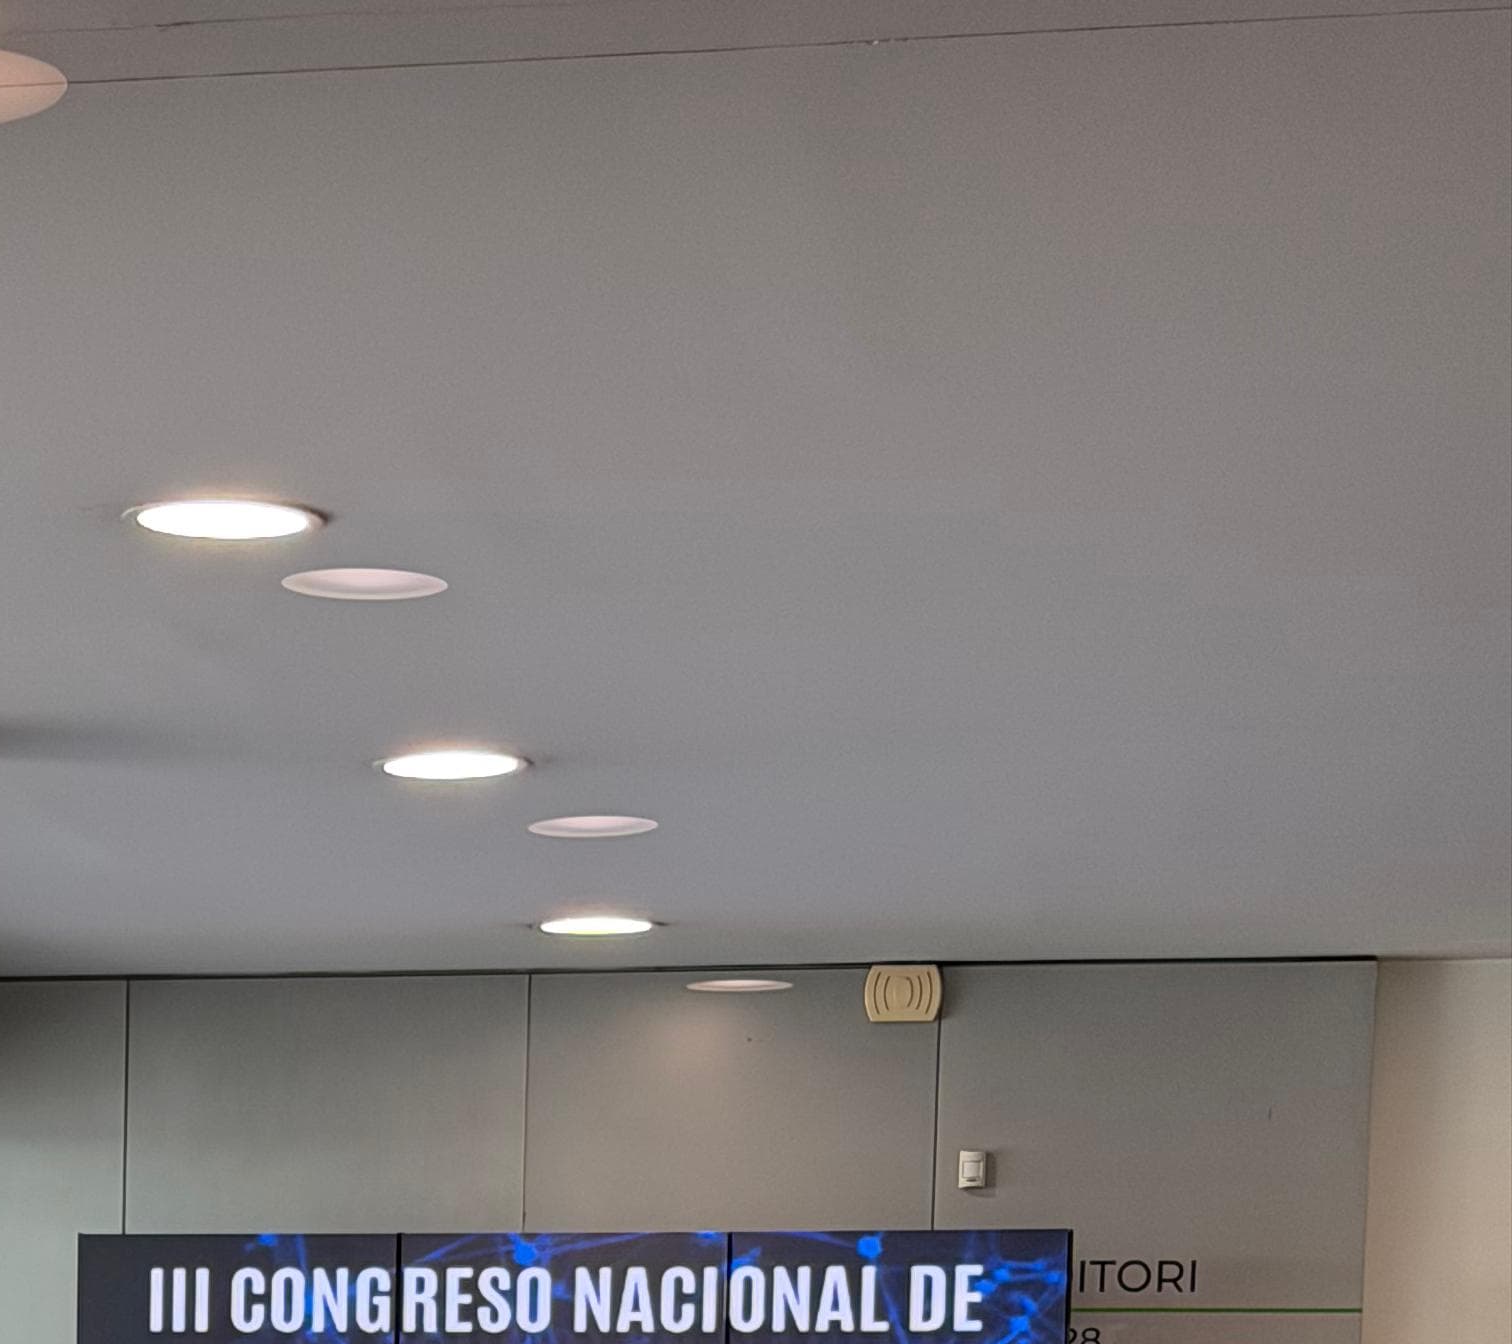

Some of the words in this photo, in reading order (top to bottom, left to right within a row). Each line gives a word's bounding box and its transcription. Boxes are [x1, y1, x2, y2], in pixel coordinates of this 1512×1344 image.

[149, 1266, 209, 1333] III
[230, 1266, 552, 1334] CONGRESO
[573, 1265, 889, 1333] NACIONAL
[908, 1264, 984, 1333] DE
[1079, 1259, 1197, 1293] ITORI
